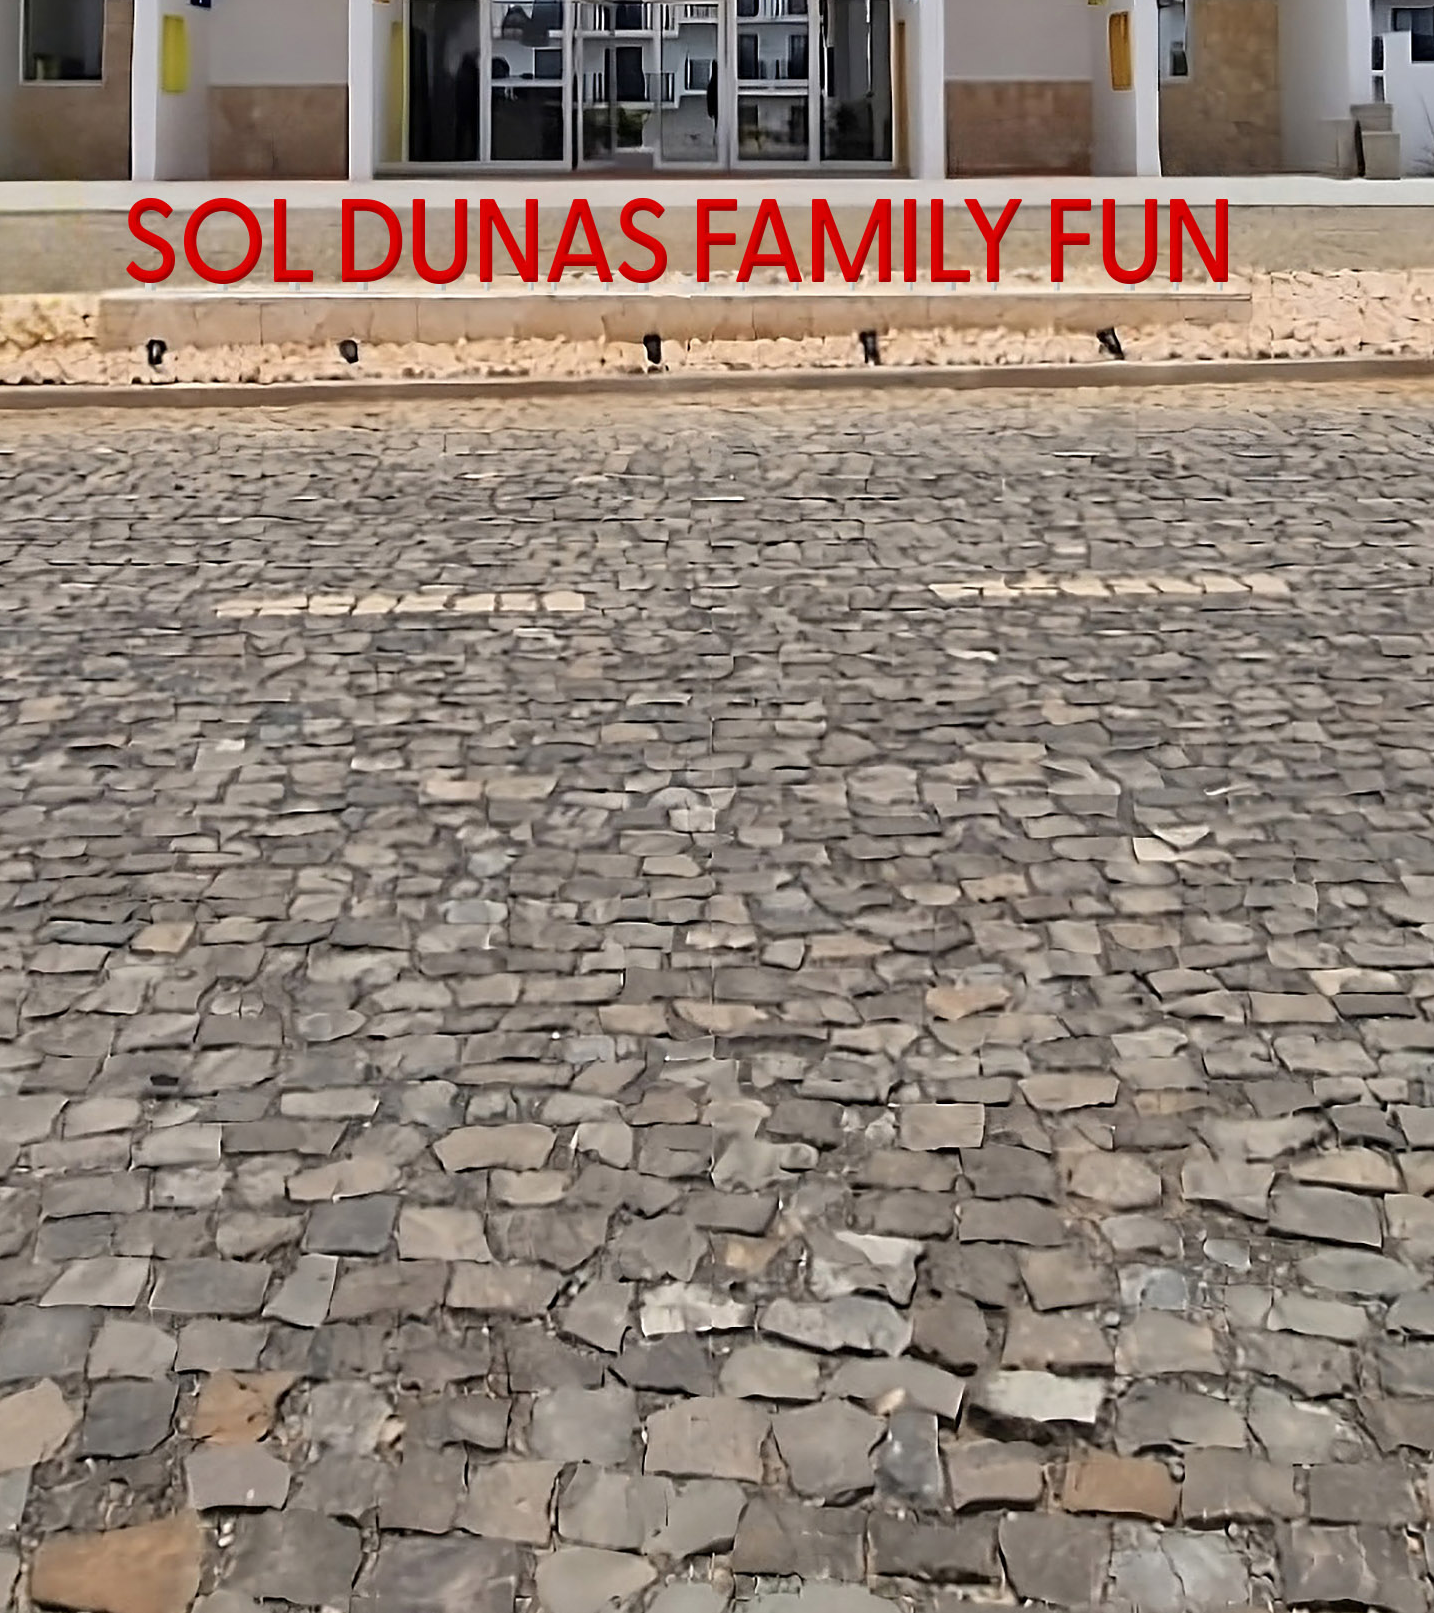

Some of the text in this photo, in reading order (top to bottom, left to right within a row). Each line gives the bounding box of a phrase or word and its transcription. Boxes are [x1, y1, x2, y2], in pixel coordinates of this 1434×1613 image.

[125, 197, 1229, 285] SOL DUNAS FAMILY FUN
